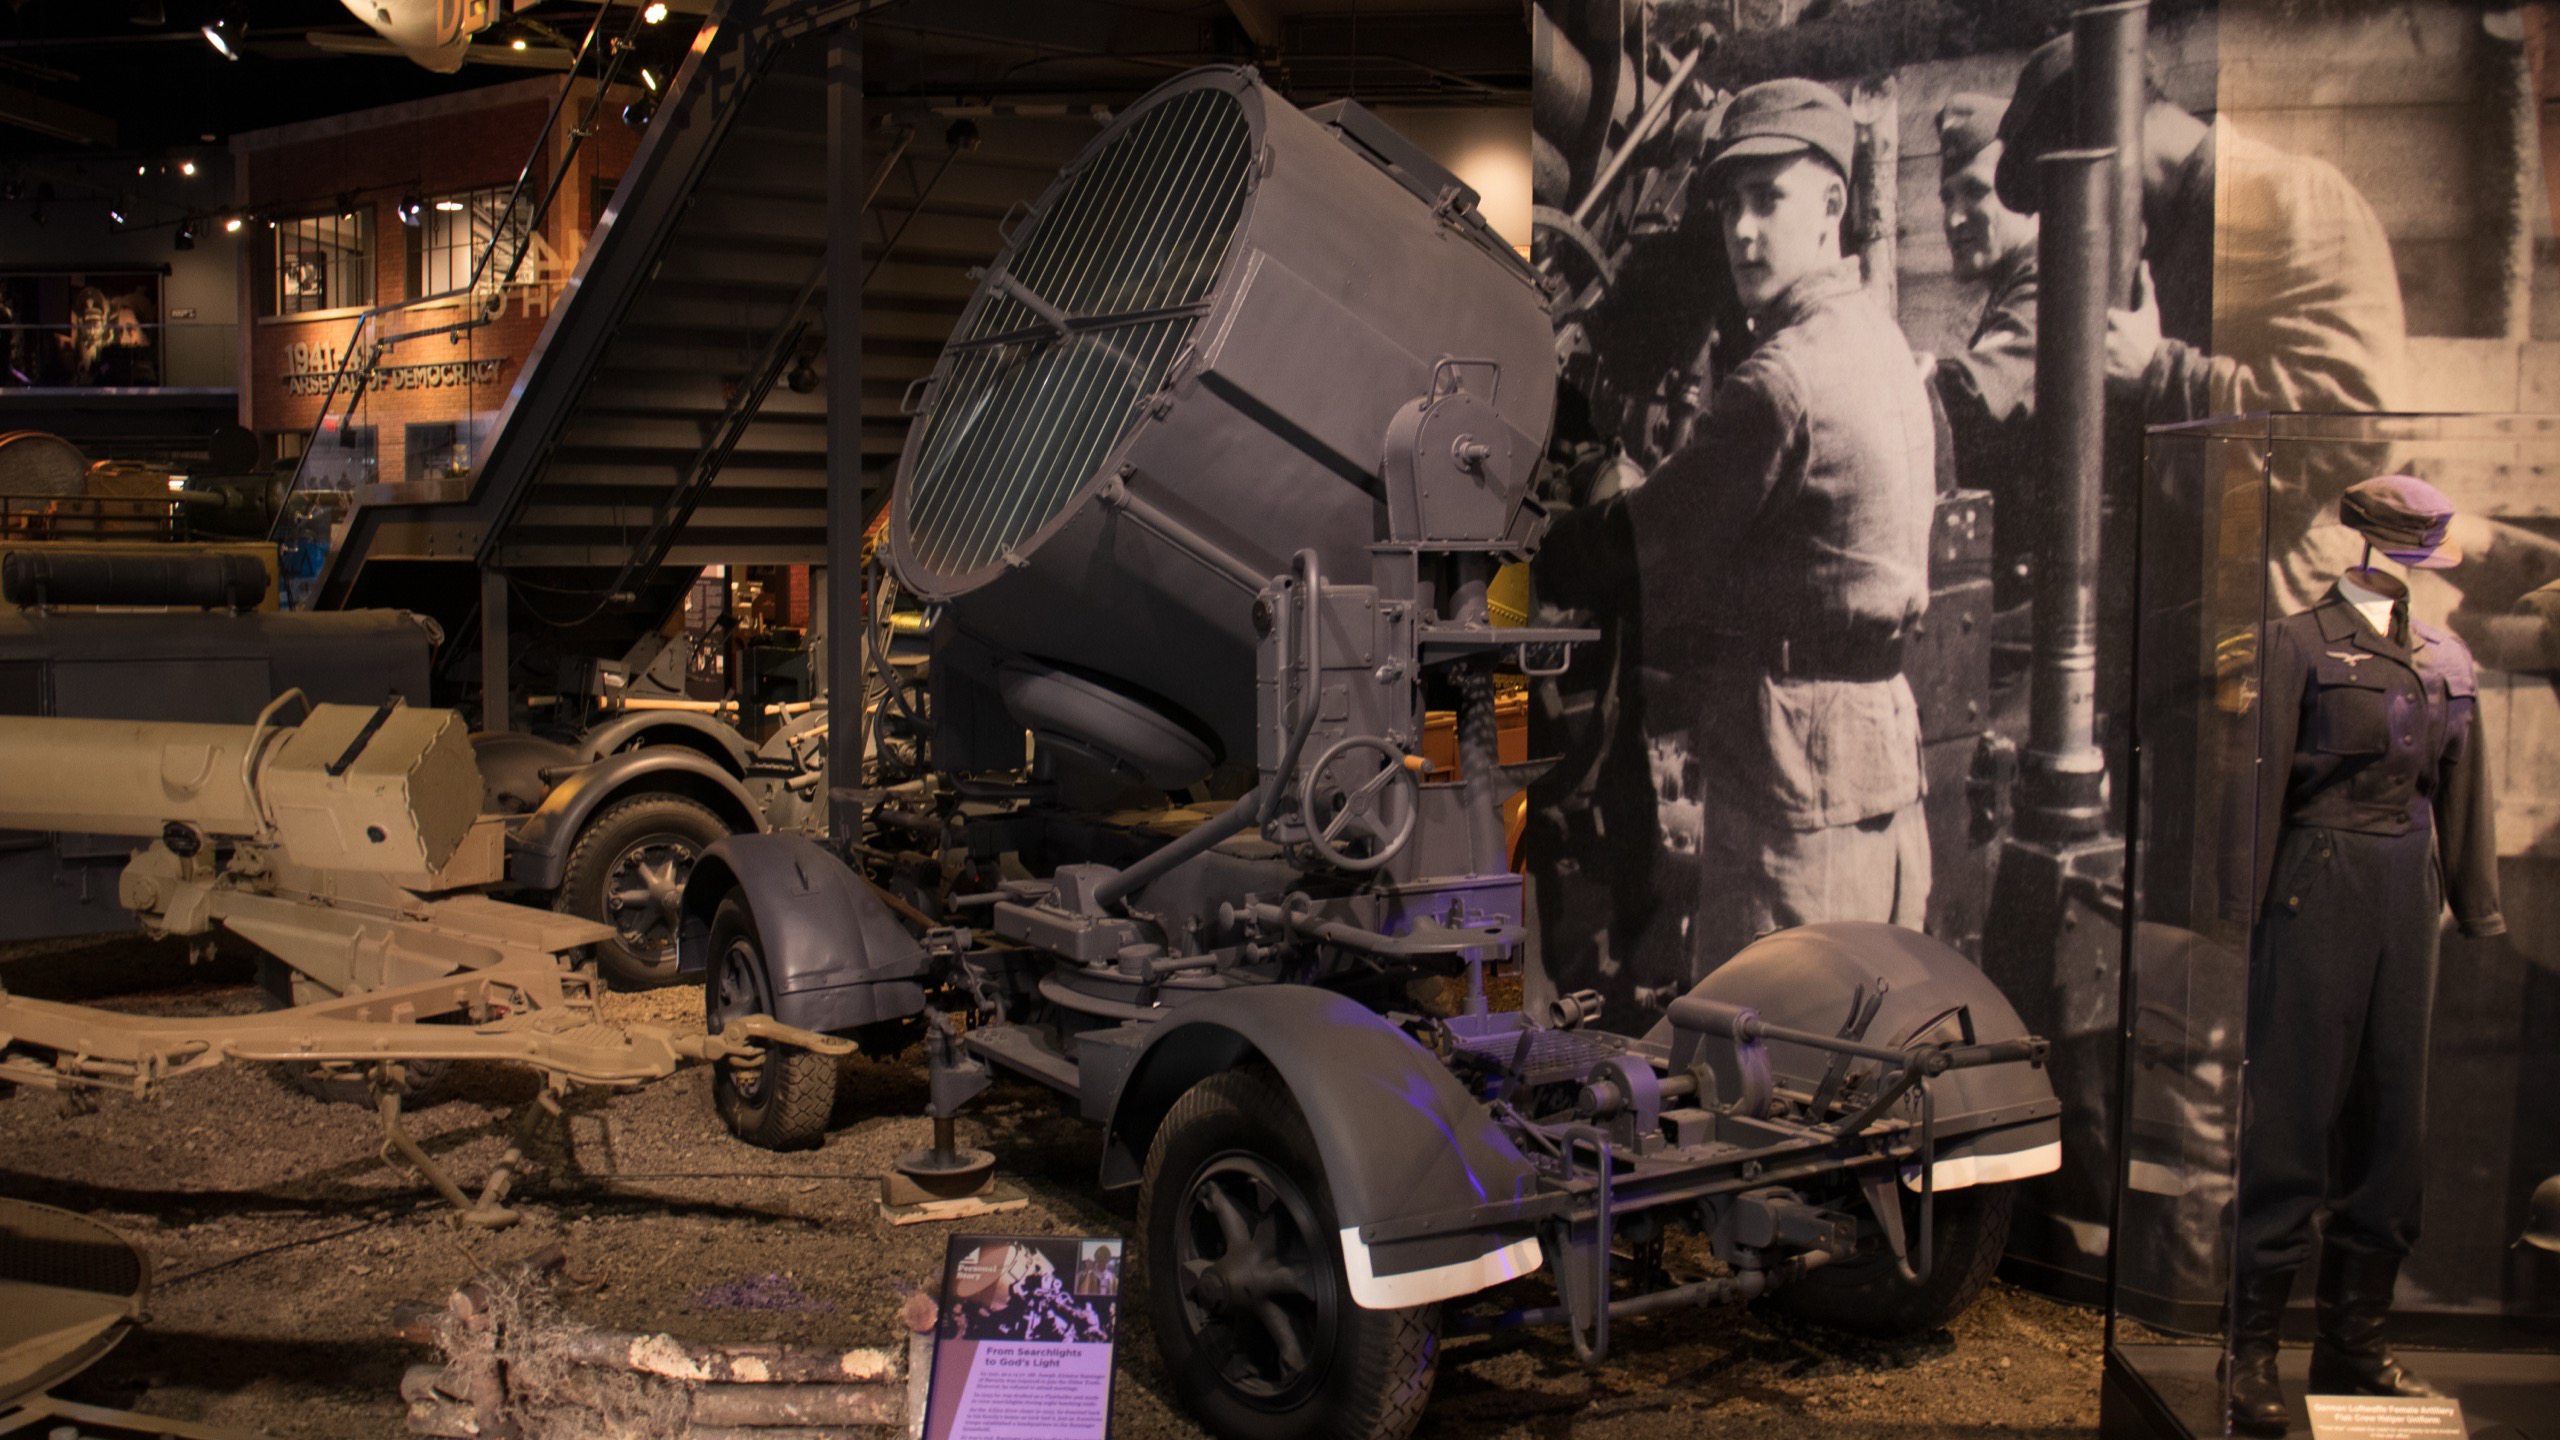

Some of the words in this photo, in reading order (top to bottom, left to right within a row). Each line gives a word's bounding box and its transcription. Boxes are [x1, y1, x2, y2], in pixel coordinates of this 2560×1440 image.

[393, 360, 500, 388] DEMOCRACY
[986, 1347, 1015, 1356] From
[1017, 1347, 1082, 1358] Searchlights
[985, 1357, 997, 1366] to
[999, 1358, 1030, 1367] God's
[1033, 1359, 1060, 1368] Light
